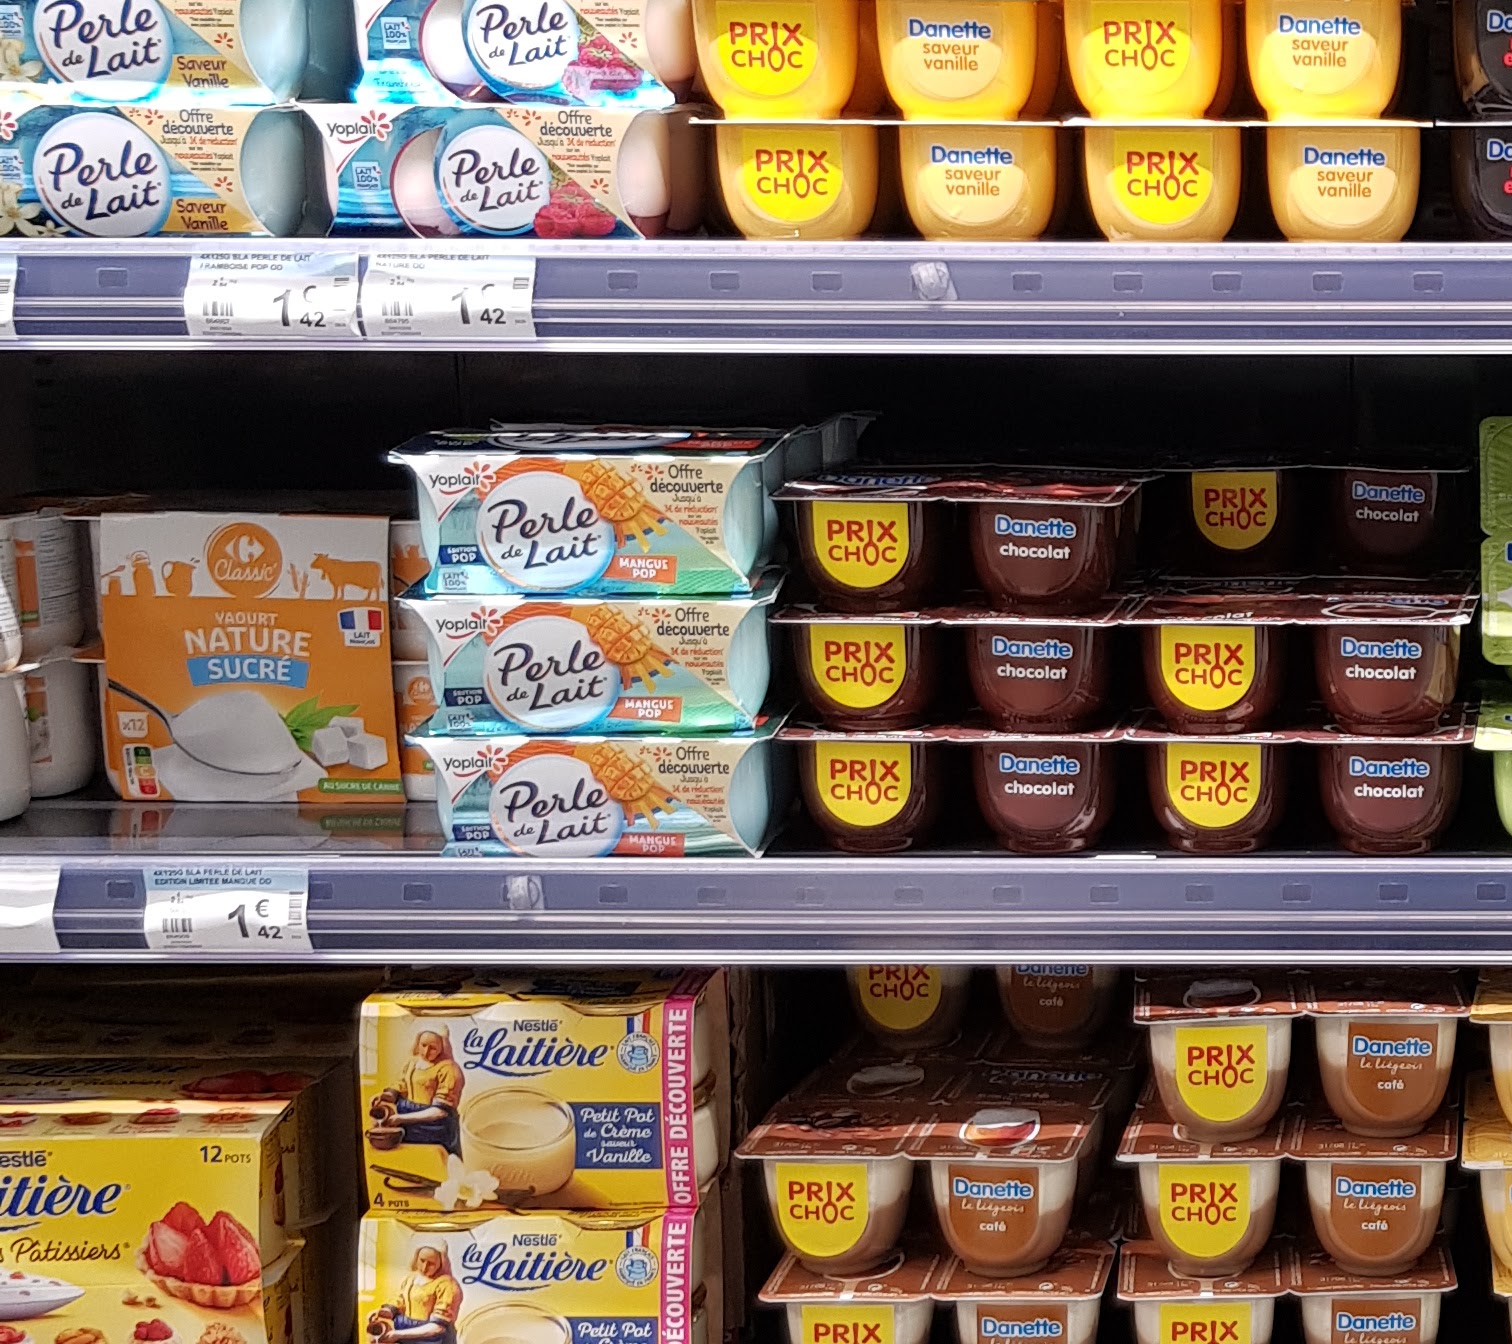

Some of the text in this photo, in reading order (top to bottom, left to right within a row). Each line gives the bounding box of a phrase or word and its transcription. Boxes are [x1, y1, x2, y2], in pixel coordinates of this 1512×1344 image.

[181, 216, 228, 231] Vanille
[273, 289, 291, 326] 1
[300, 312, 326, 327] 42
[480, 309, 506, 324] 42
[667, 465, 703, 479] Offre
[649, 479, 724, 494] découverte
[1352, 483, 1426, 504] Danette
[1356, 508, 1419, 522] chocolat
[827, 520, 898, 543] PRIX
[995, 515, 1077, 538] Danette
[451, 553, 476, 563] POP
[828, 545, 897, 566] CHOC
[1000, 544, 1071, 559] chocolat
[214, 561, 275, 582] Classic
[619, 558, 668, 571] MANGUE
[632, 568, 657, 579] POP
[215, 612, 278, 626] YAOURT
[184, 628, 312, 657] NATURE
[208, 657, 292, 681] SUCRÉ
[228, 905, 249, 938] 1
[258, 926, 283, 939] 42
[465, 1035, 609, 1076] Laitière
[667, 1009, 691, 1204] OFFRE DÉCOUVERTE
[580, 1108, 655, 1124] Petit Pot
[600, 1124, 652, 1141] Crème
[199, 1146, 251, 1163] 12 POTS
[587, 1148, 652, 1164] Vanille
[789, 1181, 855, 1203] PRIX
[954, 1177, 1033, 1199] Danette
[790, 1205, 854, 1224] CHOC
[979, 1221, 1006, 1232] café
[11, 1237, 121, 1263] Pâtissiers
